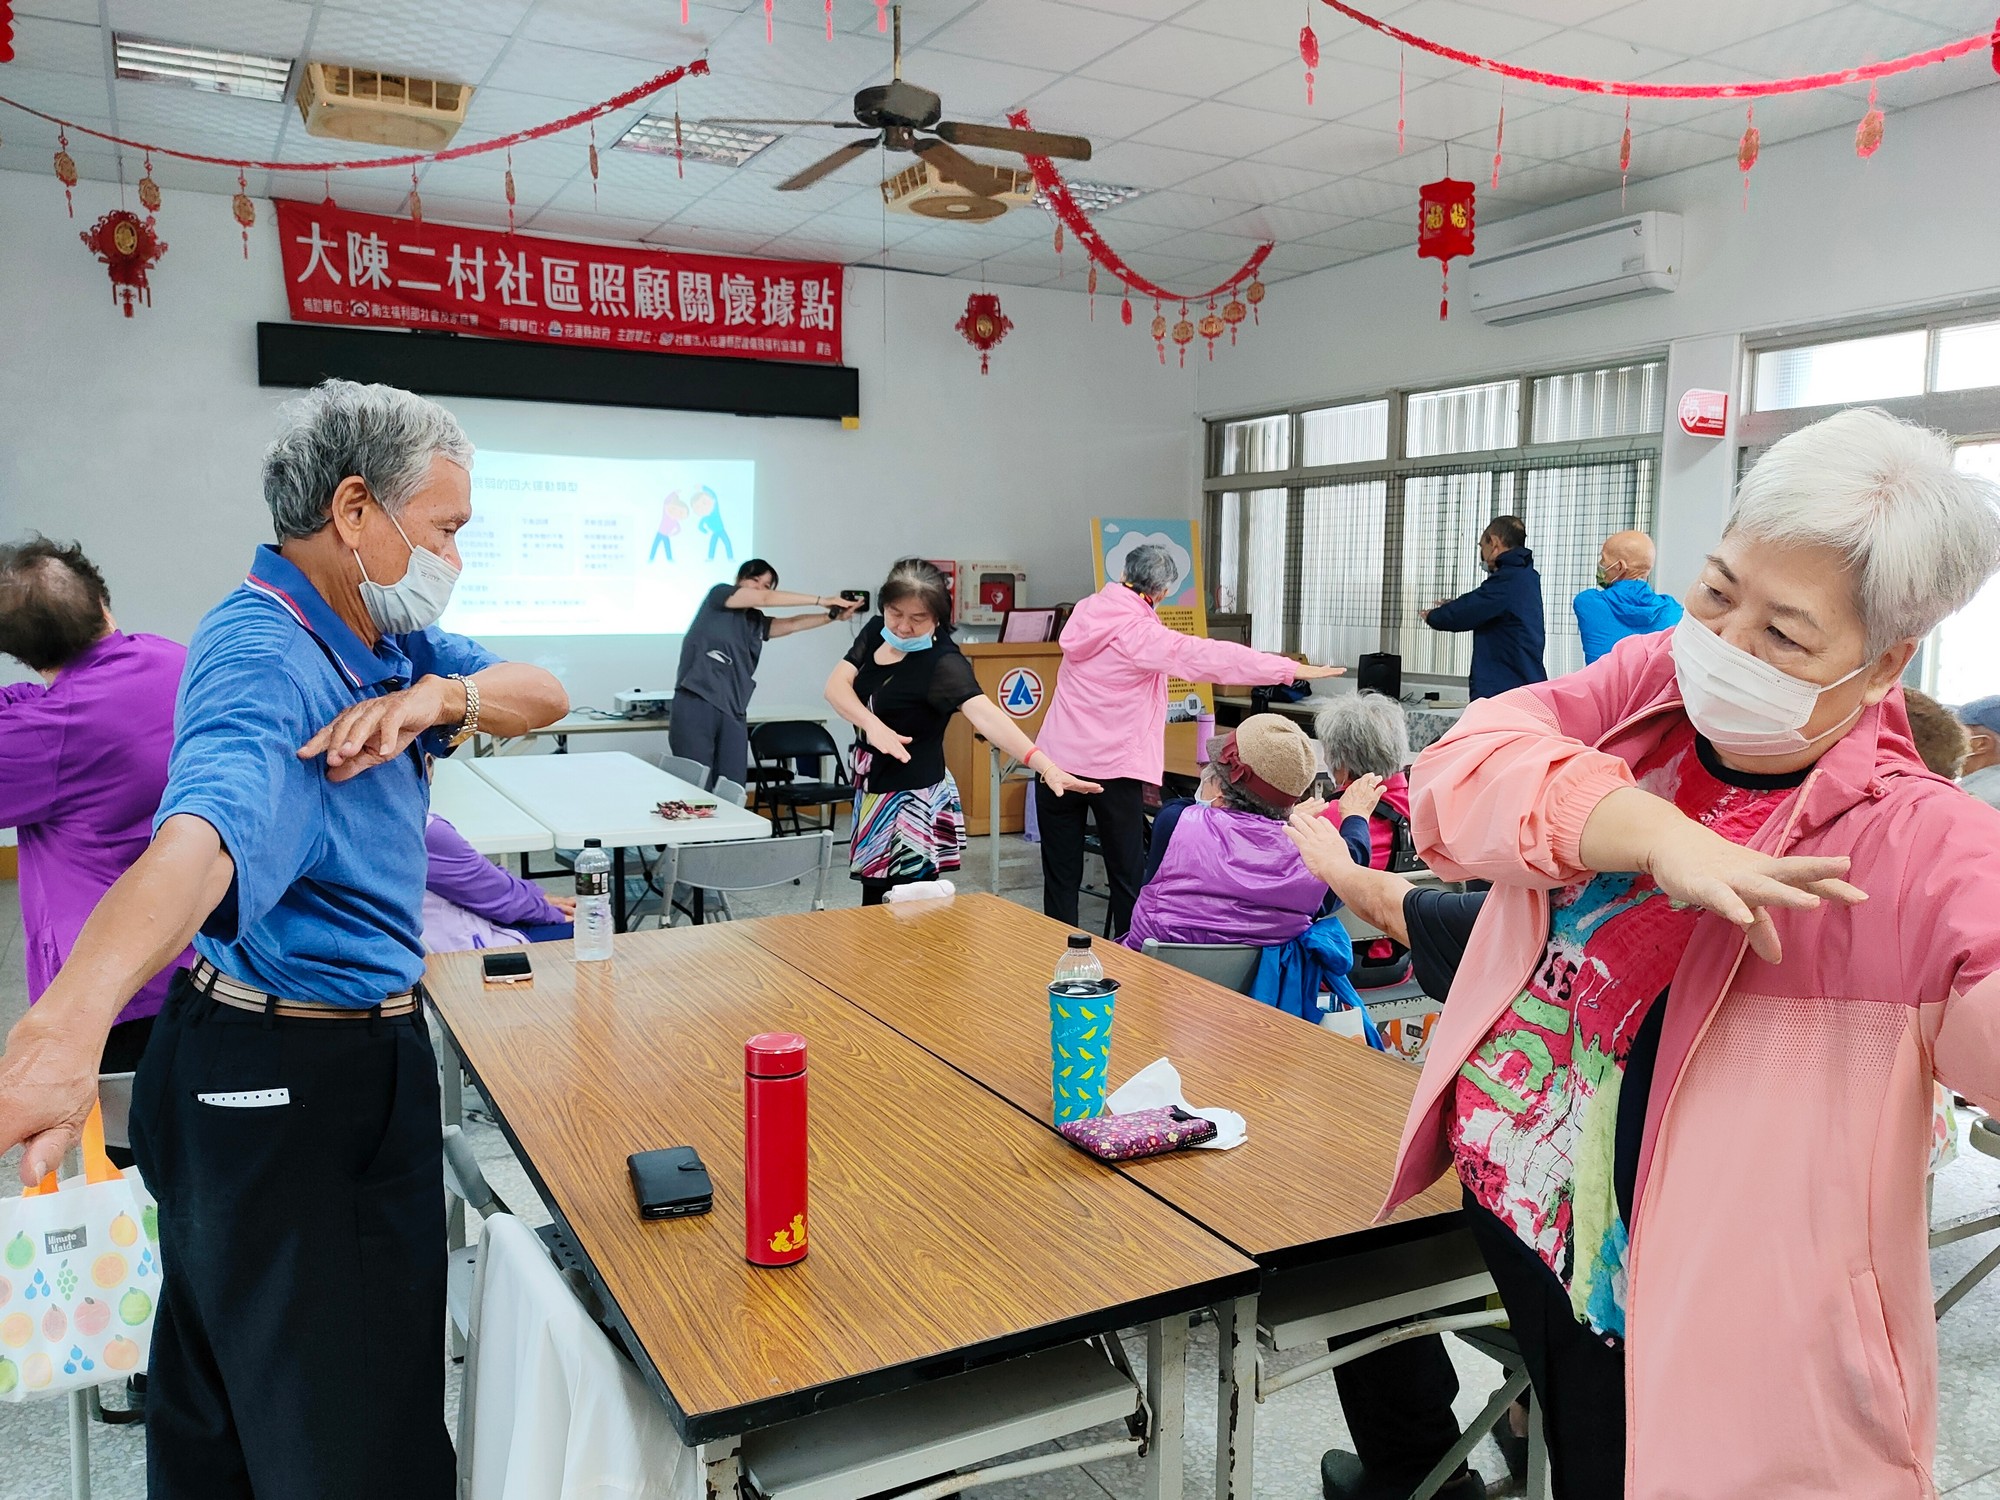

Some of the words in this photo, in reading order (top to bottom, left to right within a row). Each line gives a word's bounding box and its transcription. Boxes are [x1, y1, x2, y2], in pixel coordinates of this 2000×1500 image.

[296, 221, 835, 331] 大陳二村社區照顧關懷據點
[48, 1233, 77, 1245] Minute
